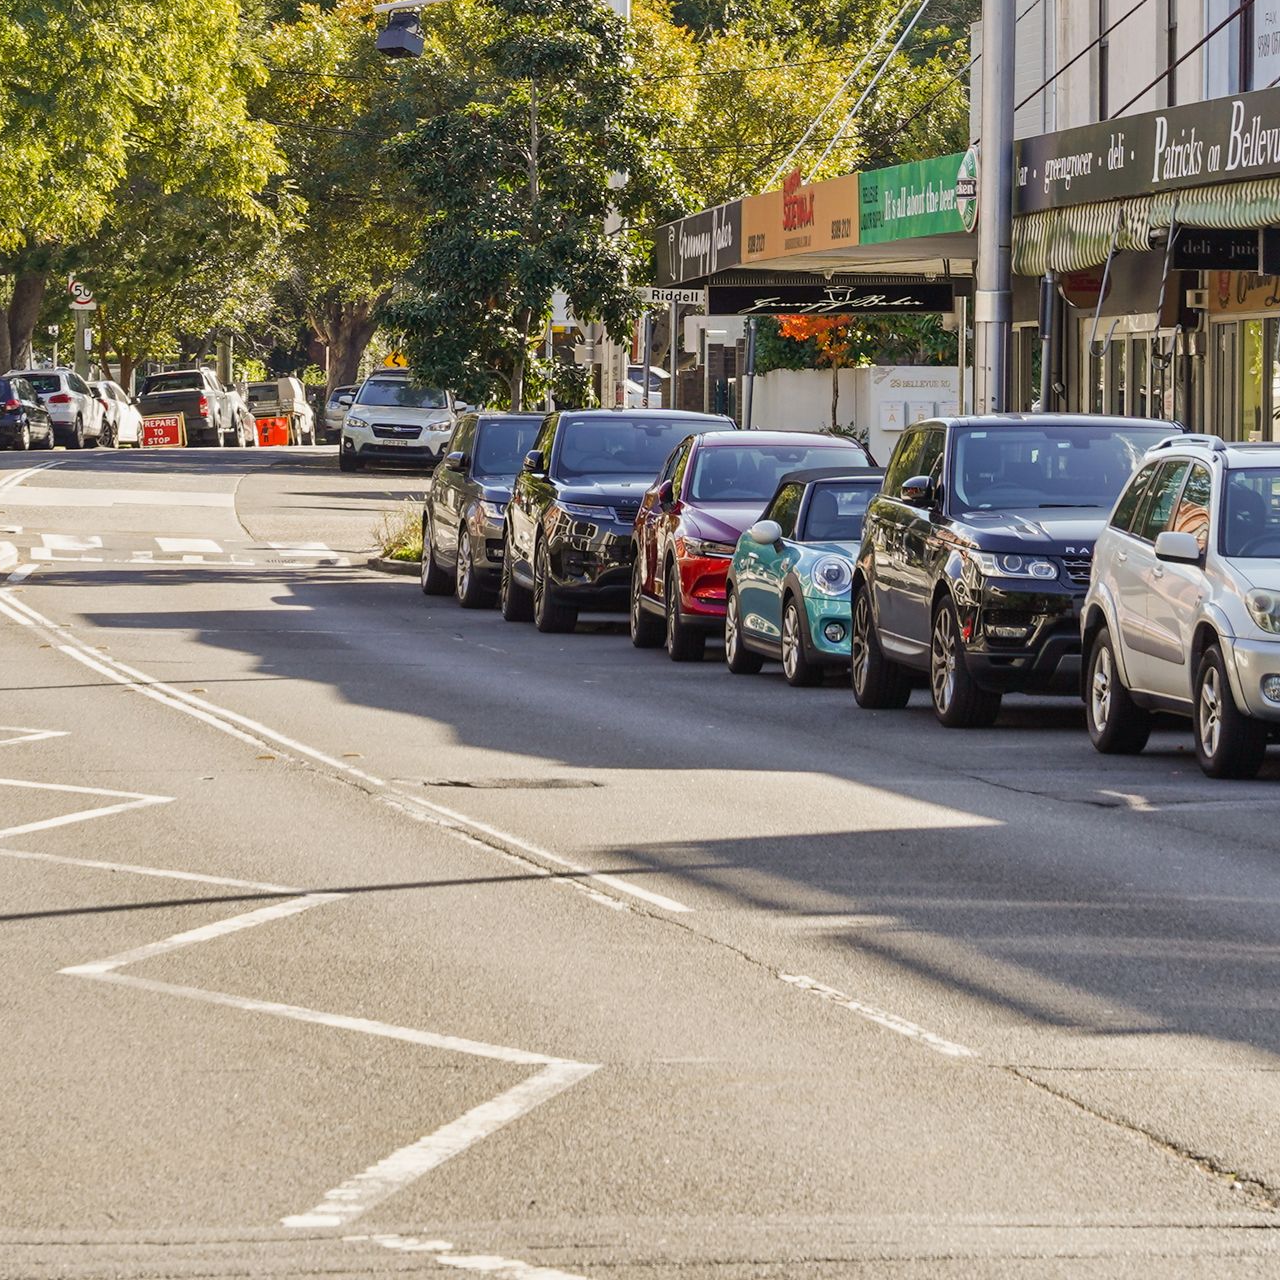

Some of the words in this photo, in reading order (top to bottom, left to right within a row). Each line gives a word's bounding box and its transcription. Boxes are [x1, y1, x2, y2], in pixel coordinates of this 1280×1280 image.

[1043, 152, 1093, 194] greengrocer
[1107, 132, 1125, 170] deli
[1152, 116, 1204, 183] Patricks
[1207, 143, 1221, 173] on
[1183, 239, 1211, 254] deli
[651, 289, 698, 302] Riddell
[902, 380, 939, 388] BELLEVUE
[144, 419, 177, 428] REPARE
[153, 428, 164, 436] TO
[147, 437, 170, 445] STOP
